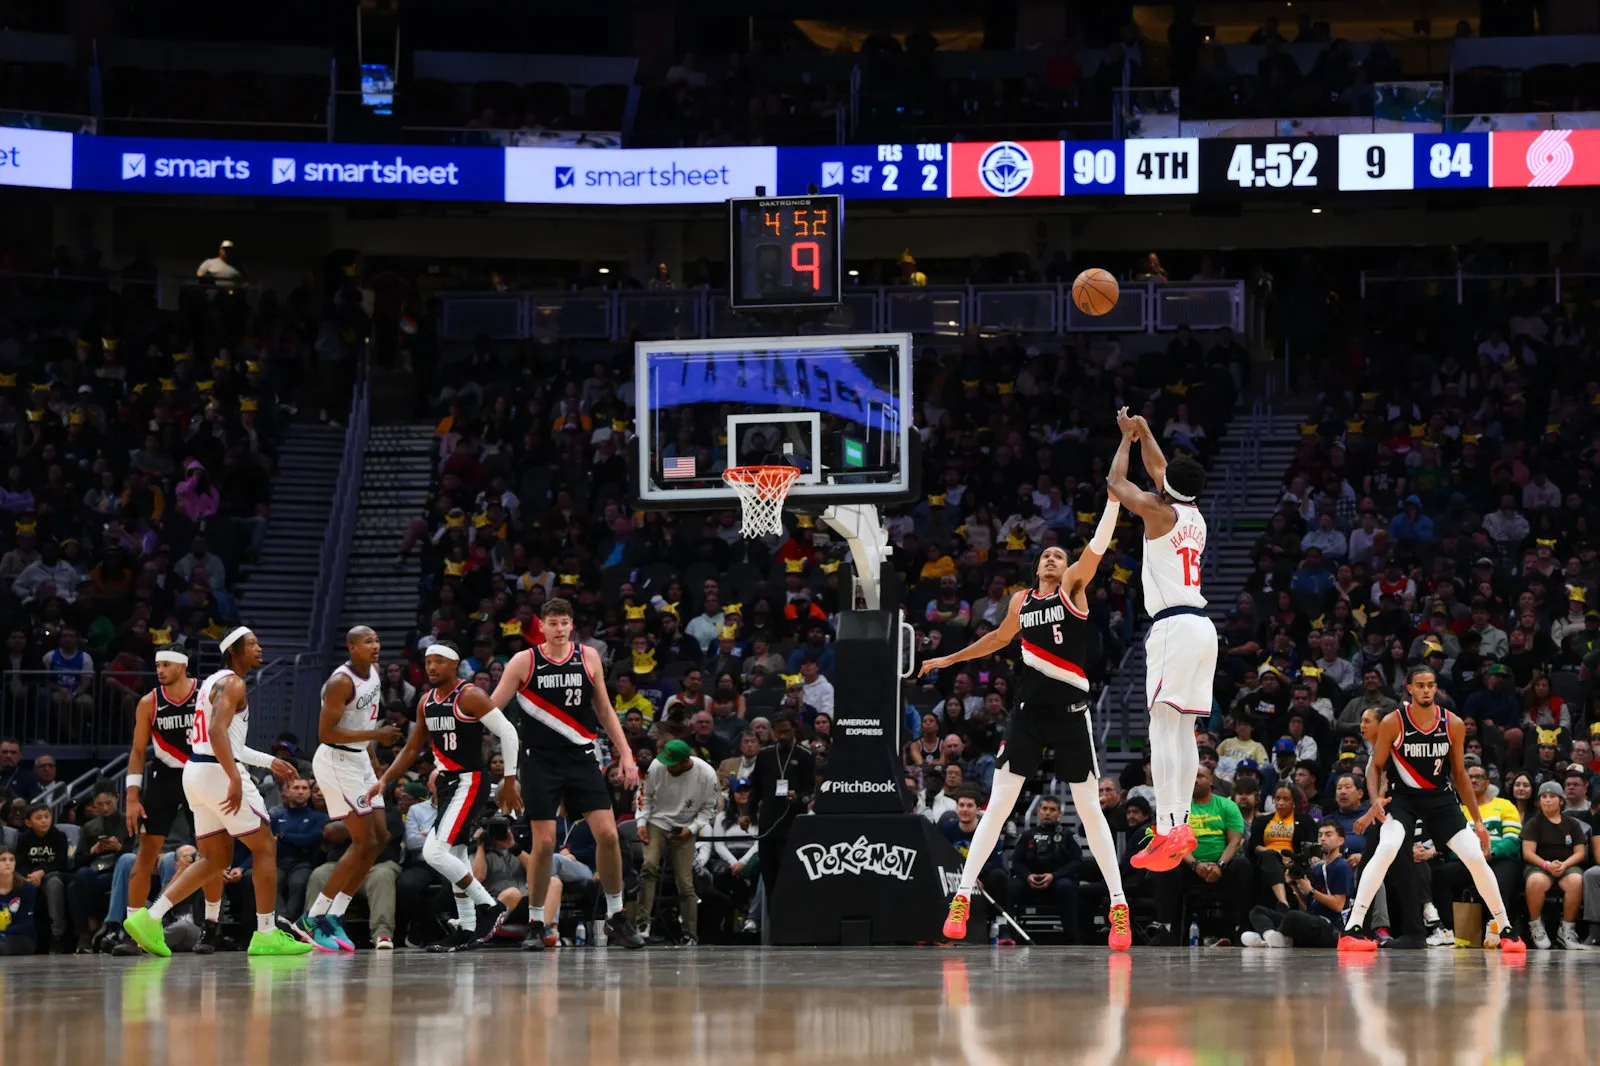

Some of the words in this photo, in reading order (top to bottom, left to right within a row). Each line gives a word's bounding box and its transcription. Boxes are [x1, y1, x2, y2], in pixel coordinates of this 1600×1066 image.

[877, 144, 903, 162] FLS
[916, 143, 943, 161] TOL
[1227, 142, 1319, 188] 4:52
[1366, 146, 1386, 178] 9
[1429, 143, 1473, 178] 84
[154, 155, 250, 180] smarts
[303, 156, 459, 185] smartsheet
[585, 161, 729, 187] smartsheet
[881, 164, 899, 191] 2
[921, 164, 938, 191] 2
[1073, 149, 1116, 184] 90
[1136, 152, 1188, 180] 4TH
[759, 199, 812, 207] DAKTRONICS
[764, 212, 780, 236] 4
[793, 209, 827, 237] 52
[790, 242, 820, 290] 9
[1176, 546, 1202, 587] 15
[1019, 605, 1065, 629] PORTLAND
[1052, 623, 1064, 645] 5
[537, 673, 582, 689] PORTLAND
[565, 688, 582, 707] 23
[837, 718, 880, 726] AMERICAN
[846, 728, 883, 736] EXPRESS
[442, 732, 458, 751] 18
[1403, 742, 1450, 757] PORTLAND
[832, 779, 896, 793] PitchBook
